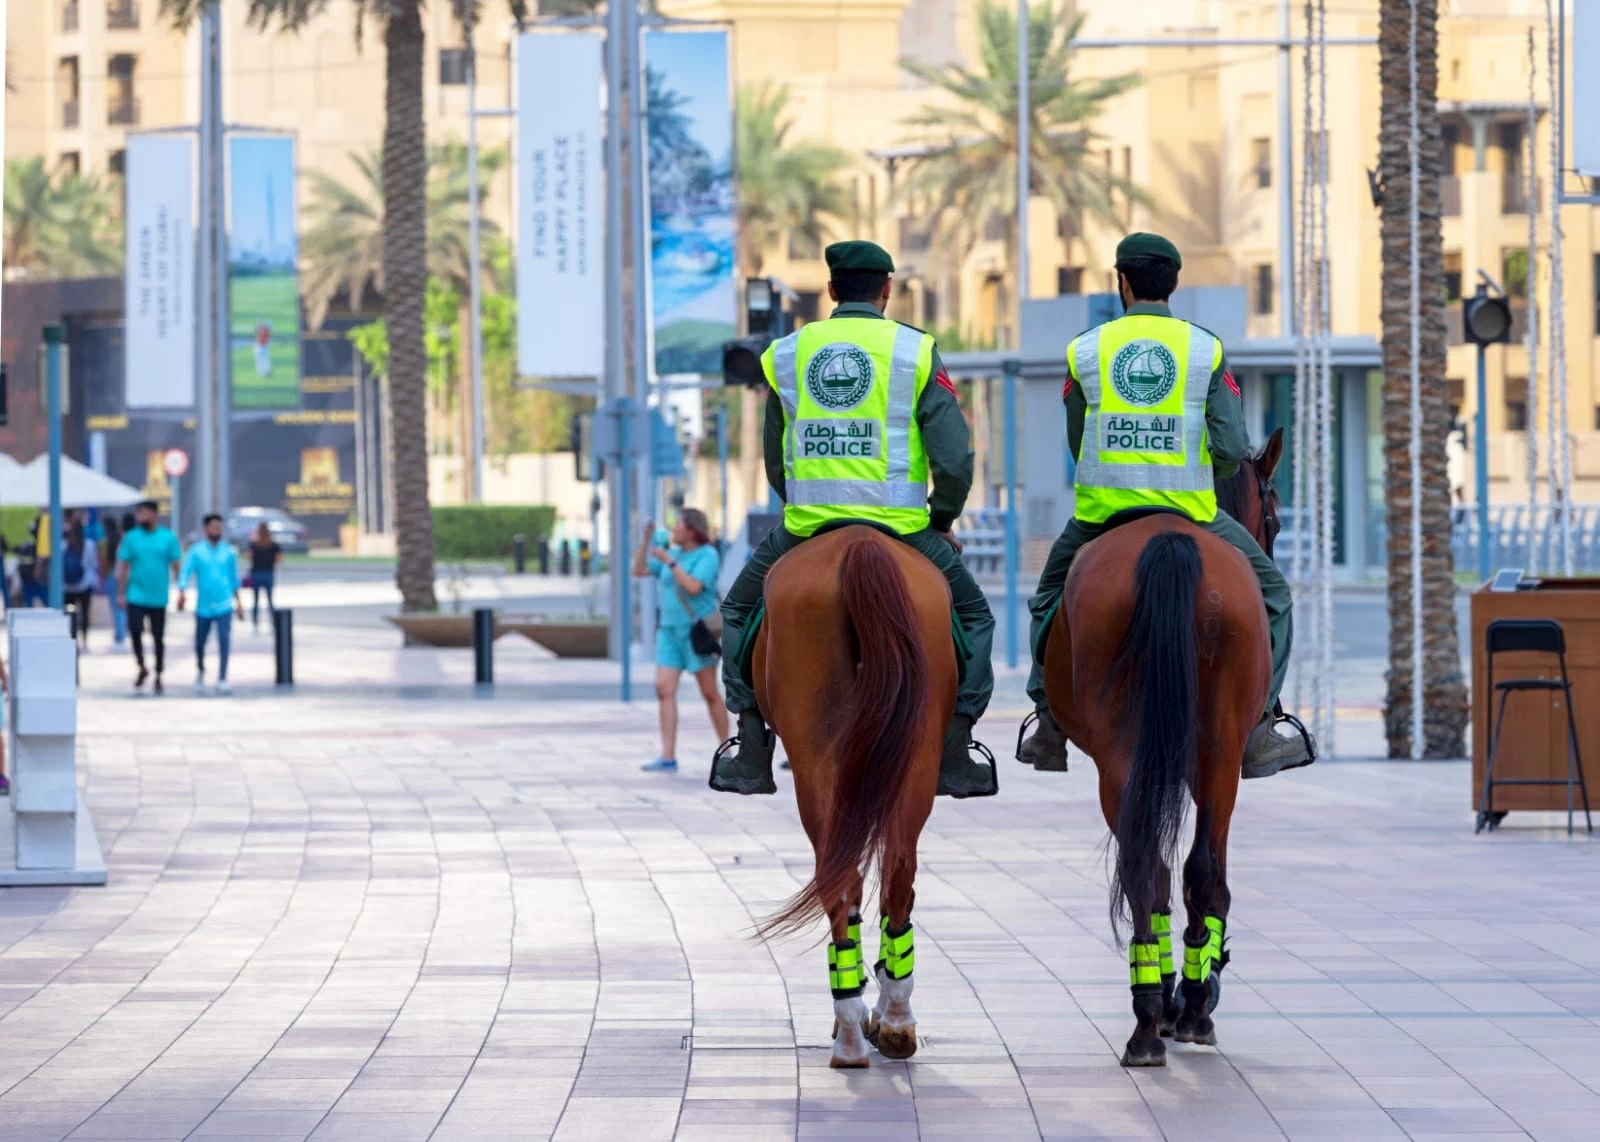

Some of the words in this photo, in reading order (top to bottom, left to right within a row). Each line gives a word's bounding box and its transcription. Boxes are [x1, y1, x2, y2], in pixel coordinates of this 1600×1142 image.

[532, 150, 546, 203] YOUR
[553, 135, 568, 200] PLACE
[532, 211, 546, 257] FIND
[554, 208, 568, 274] HAPPY
[804, 441, 872, 456] POLICE
[1107, 434, 1174, 450] POLICE
